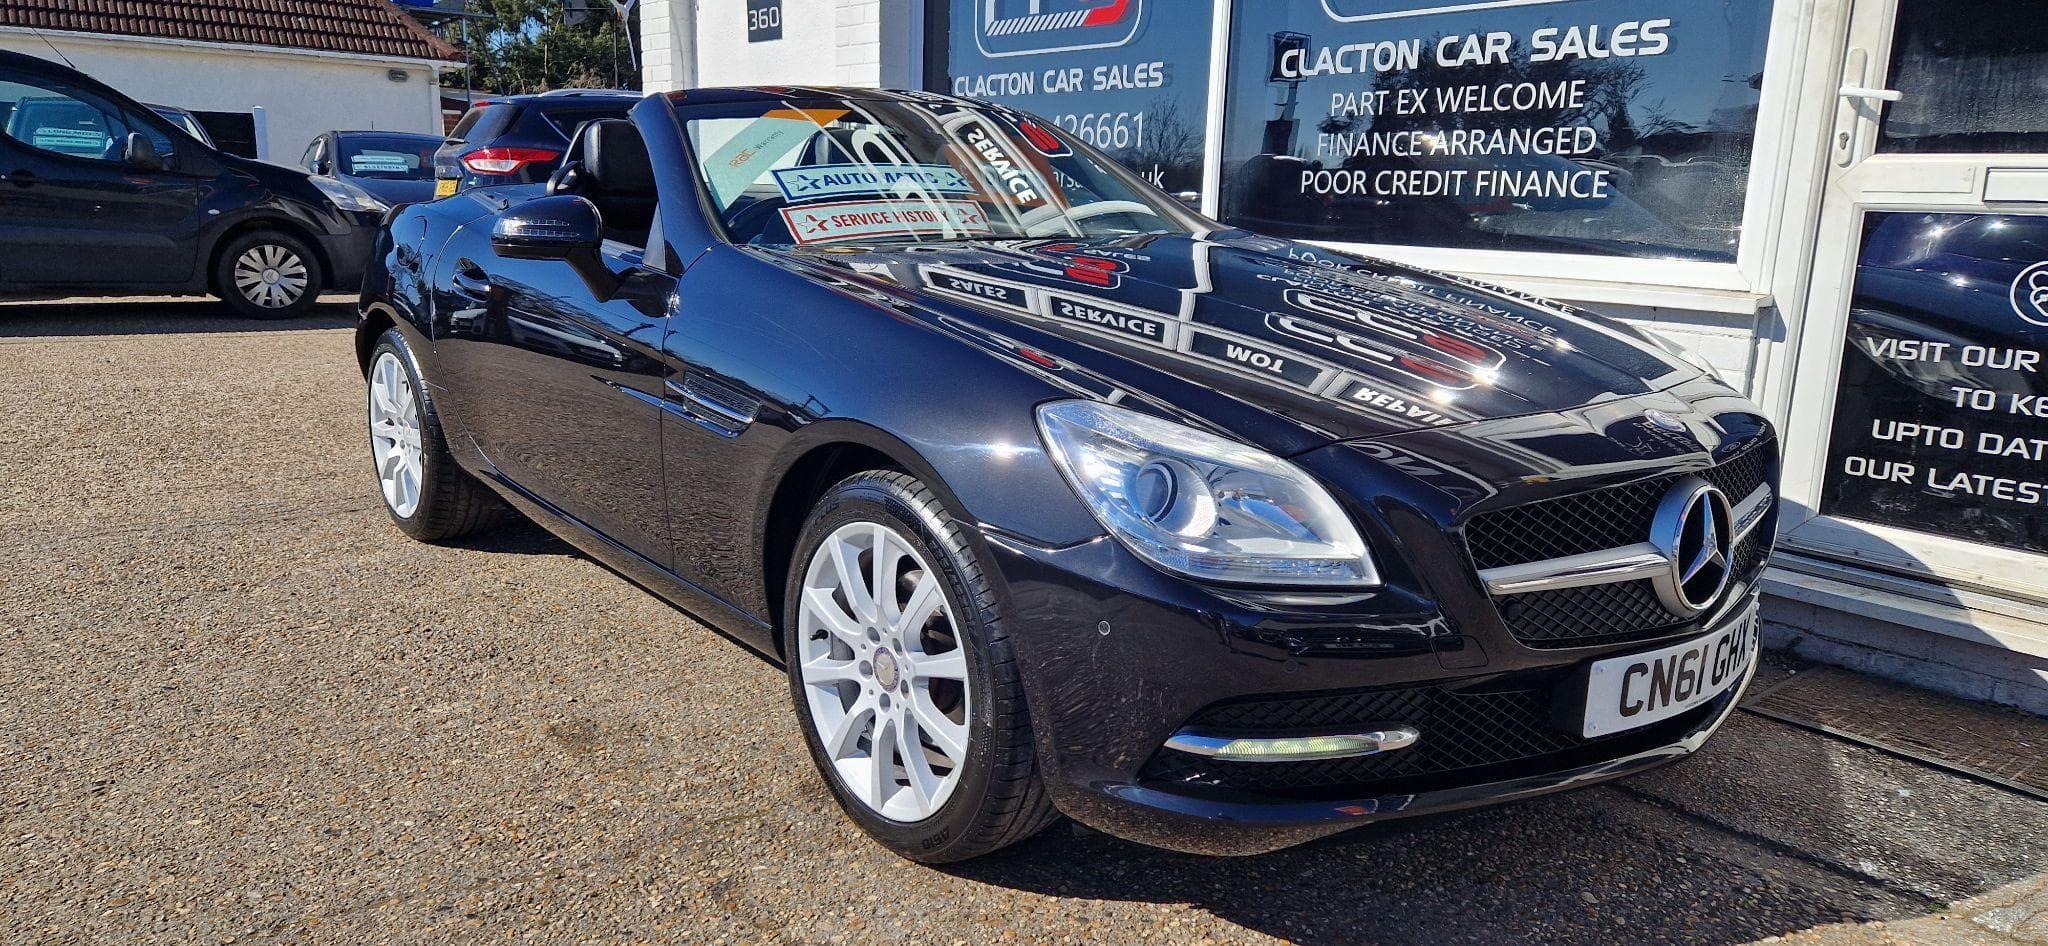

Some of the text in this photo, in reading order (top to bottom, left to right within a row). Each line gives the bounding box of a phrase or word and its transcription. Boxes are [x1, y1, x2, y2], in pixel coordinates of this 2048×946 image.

[749, 6, 780, 31] 360
[1281, 18, 1672, 79] CLACTON CAR SALES
[954, 61, 1164, 97] CLACTON CAR SALES
[1331, 79, 1586, 117] PART EX WELCOME
[1317, 125, 1597, 157] FINANCE ARRANGED
[1300, 169, 1610, 199] POOR CREDIT FINANCE
[831, 211, 892, 228] SERVICE
[1866, 336, 2040, 373] VISIT OUR
[1951, 386, 1997, 411] TO
[1872, 418, 1965, 450] UPTO
[1844, 455, 1915, 485] OUR
[1619, 643, 1710, 719] CN61
[1711, 612, 1752, 687] GHX
